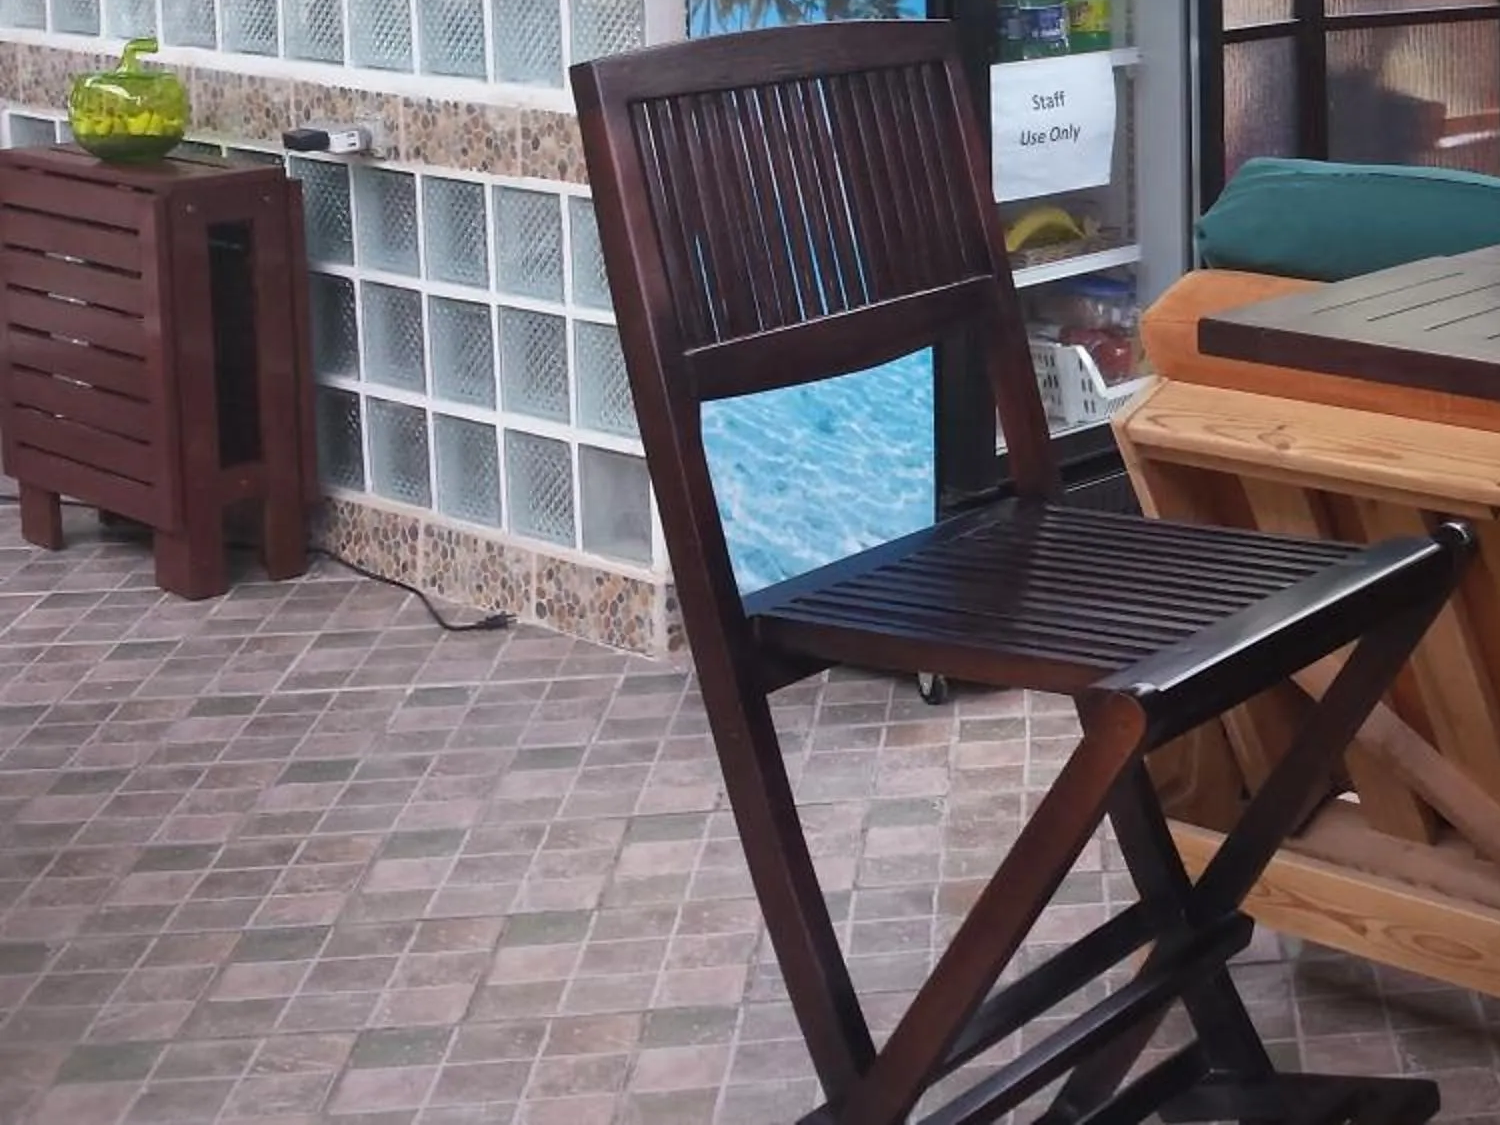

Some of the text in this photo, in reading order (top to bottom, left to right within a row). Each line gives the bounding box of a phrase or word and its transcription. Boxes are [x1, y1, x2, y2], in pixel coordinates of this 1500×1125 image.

[1031, 91, 1066, 110] Staff
[1020, 123, 1081, 146] Use Only
